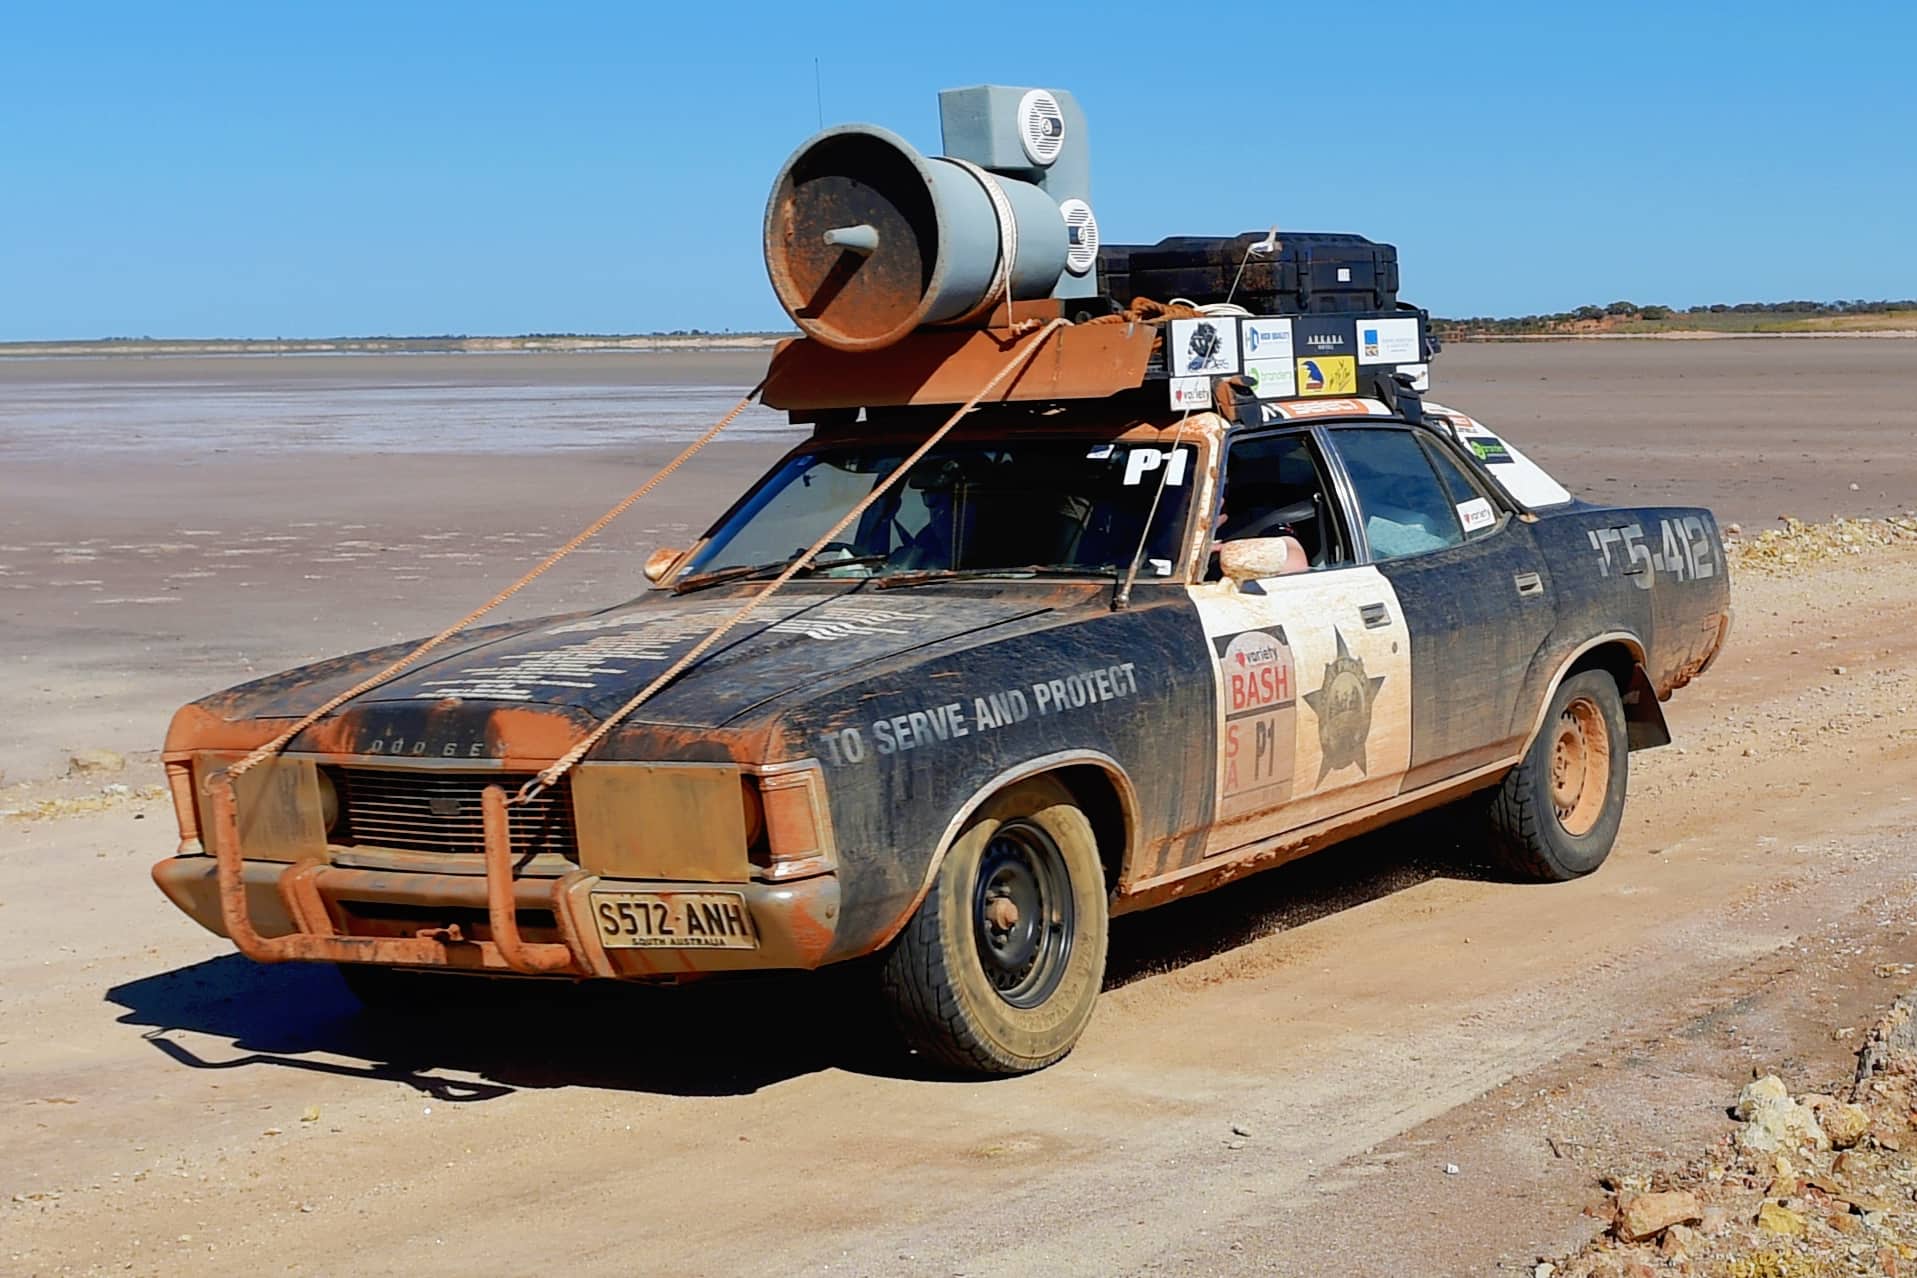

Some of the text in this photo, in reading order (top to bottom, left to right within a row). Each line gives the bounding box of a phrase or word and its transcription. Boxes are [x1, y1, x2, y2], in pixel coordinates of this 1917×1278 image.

[1123, 448, 1189, 486] P1
[1247, 647, 1278, 662] variety
[1232, 665, 1288, 710] BASH
[819, 662, 1138, 767] TO SERVE AND PROTECT
[371, 738, 484, 757] DODGE
[632, 937, 727, 946] SOUTH AUSTRALIA
